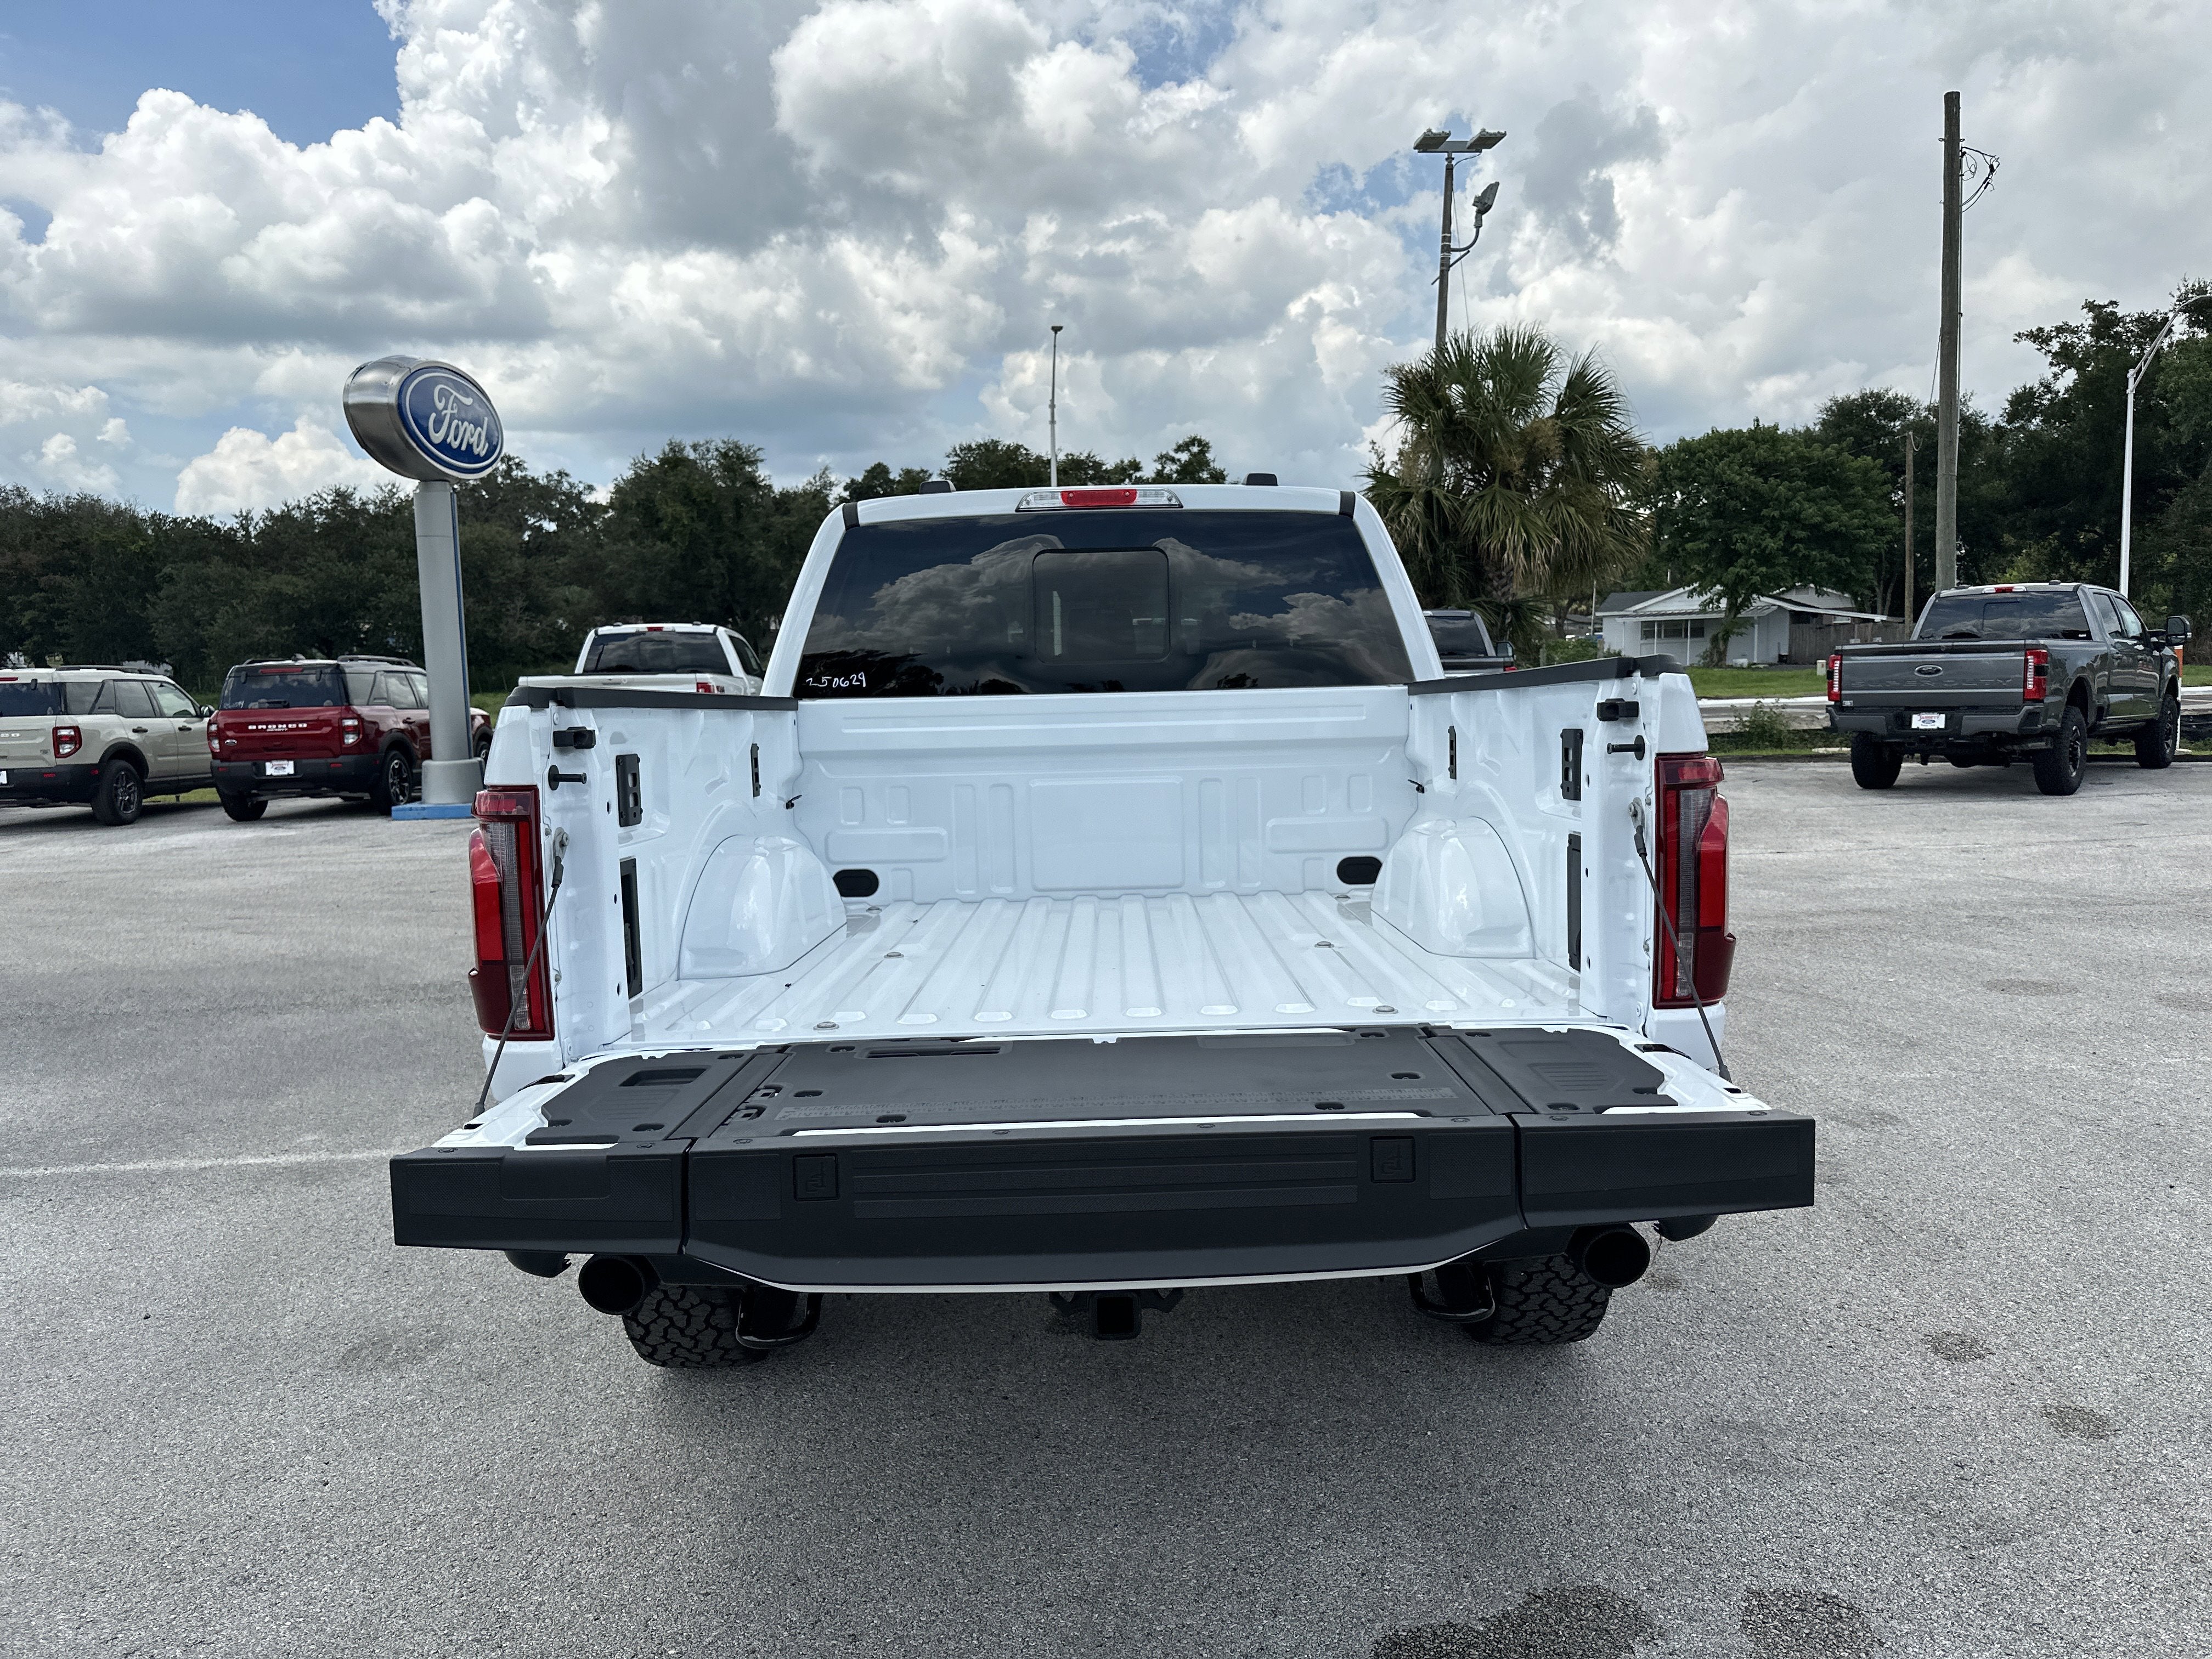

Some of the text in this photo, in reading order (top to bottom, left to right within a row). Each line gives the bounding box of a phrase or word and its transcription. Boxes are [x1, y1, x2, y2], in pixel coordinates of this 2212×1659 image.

[428, 384, 489, 457] Ford
[806, 672, 866, 688] 250629
[1943, 678, 2013, 686] DUTY
